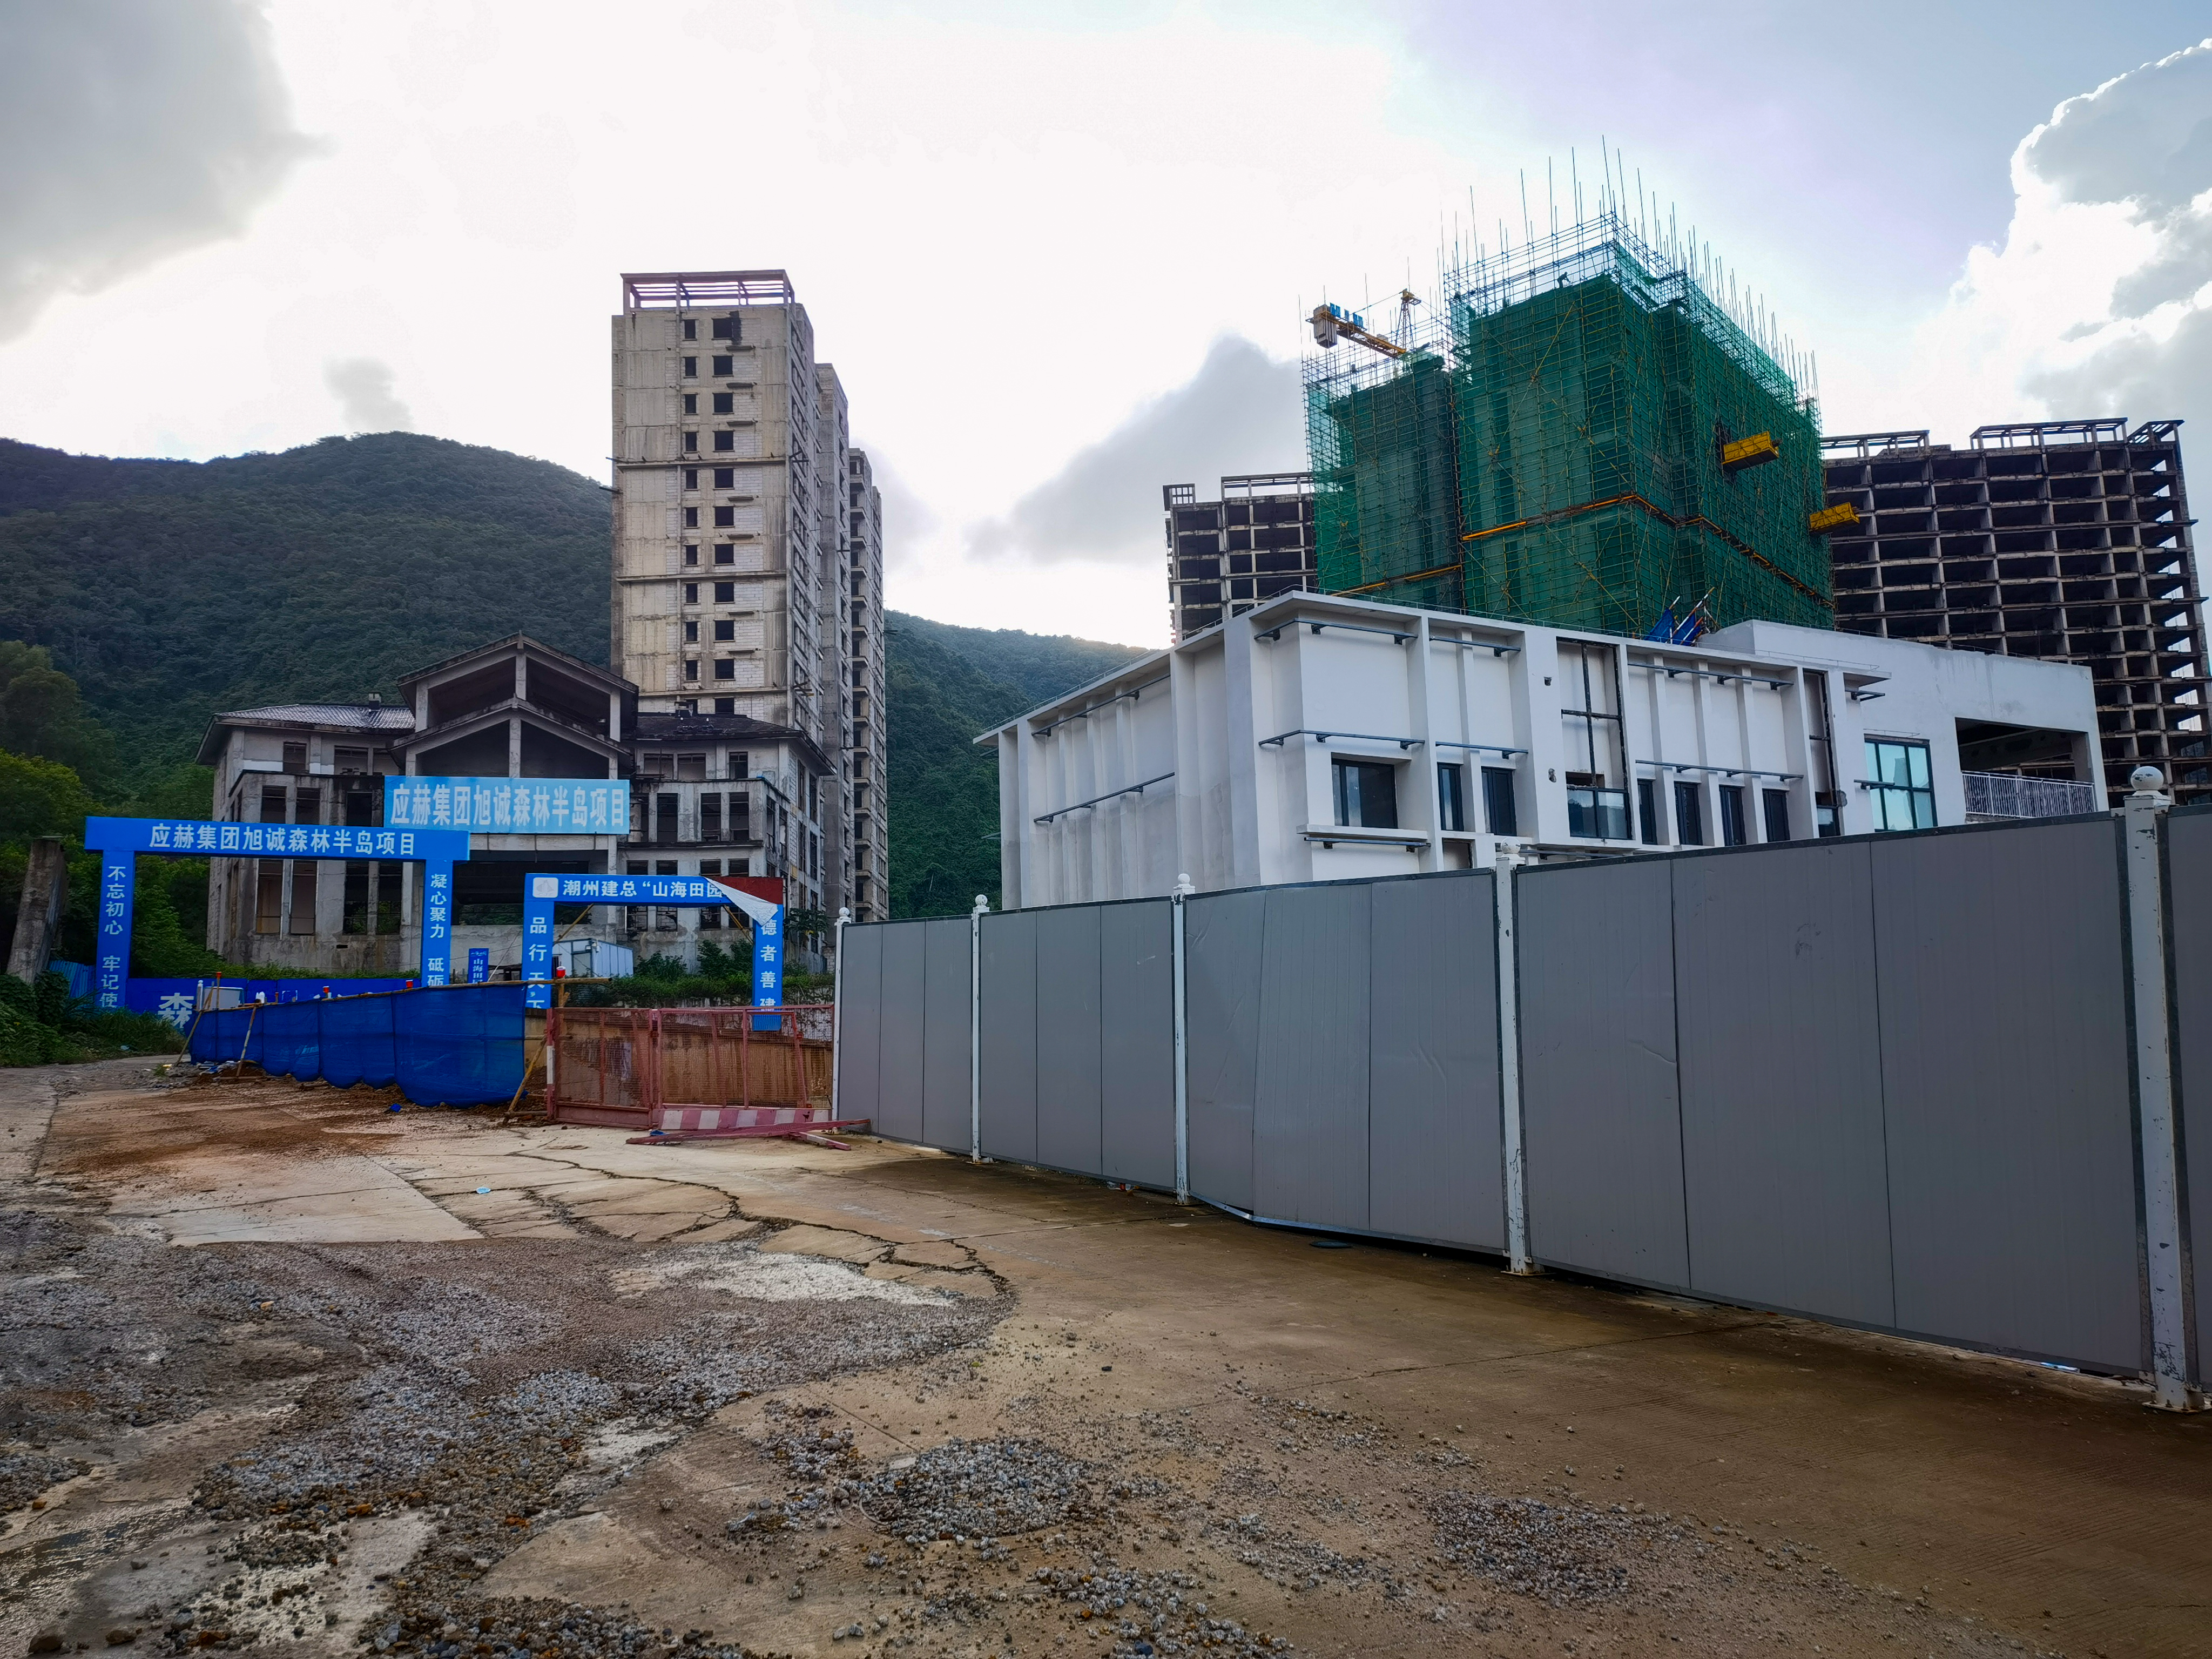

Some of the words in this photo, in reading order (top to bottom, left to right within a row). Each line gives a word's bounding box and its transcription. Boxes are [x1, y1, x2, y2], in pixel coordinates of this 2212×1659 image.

[391, 784, 623, 826] 应赫集团旭诚森林半岛项目
[149, 823, 414, 855] 应赫集团旭诚森林半岛项目
[104, 866, 126, 935] 不忘初心
[430, 874, 447, 938] 凝心聚力
